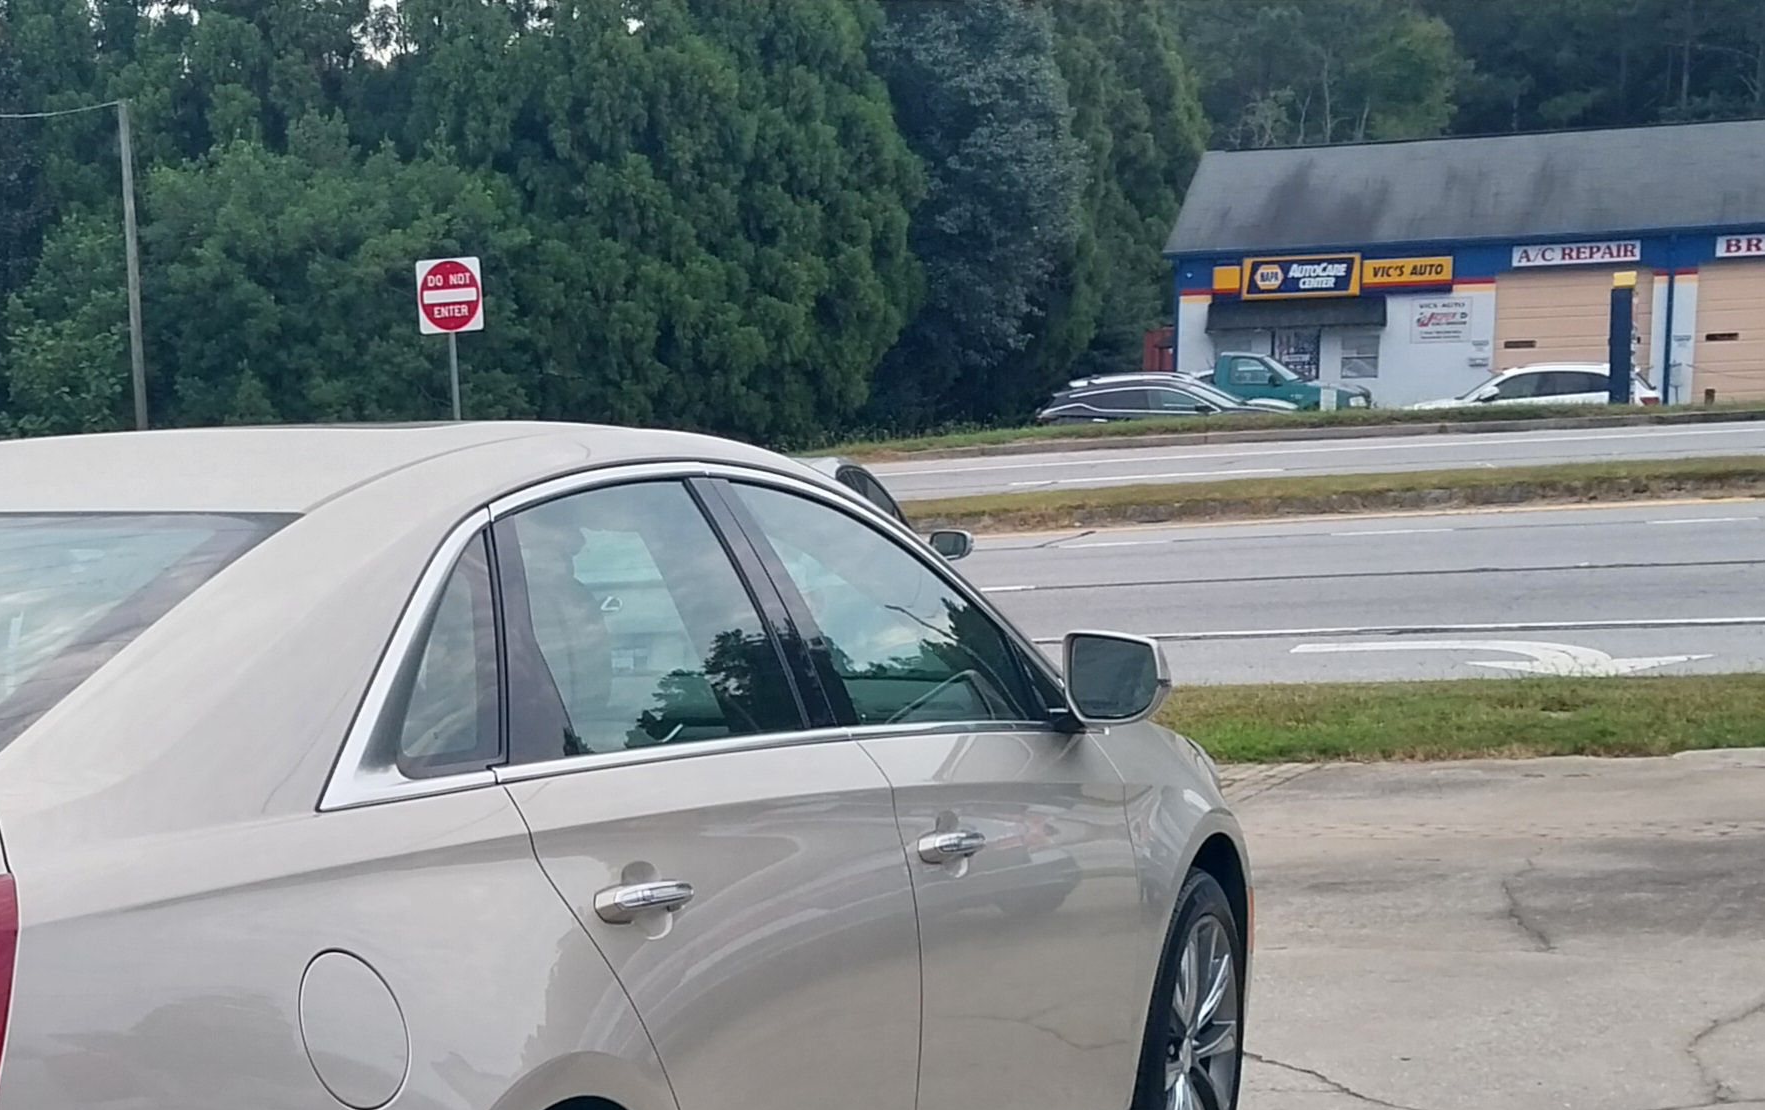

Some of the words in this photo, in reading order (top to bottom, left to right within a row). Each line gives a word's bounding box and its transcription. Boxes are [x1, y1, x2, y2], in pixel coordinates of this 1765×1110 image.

[1517, 247, 1555, 263] A/C
[1560, 243, 1637, 261] REPAIR
[1259, 270, 1280, 283] NAPA
[1372, 265, 1405, 278] VIC'S
[1410, 263, 1444, 276] AUTO
[427, 274, 444, 287] DO
[449, 272, 471, 285] NOT
[1299, 277, 1336, 289] CENTER
[433, 304, 469, 318] ENTER
